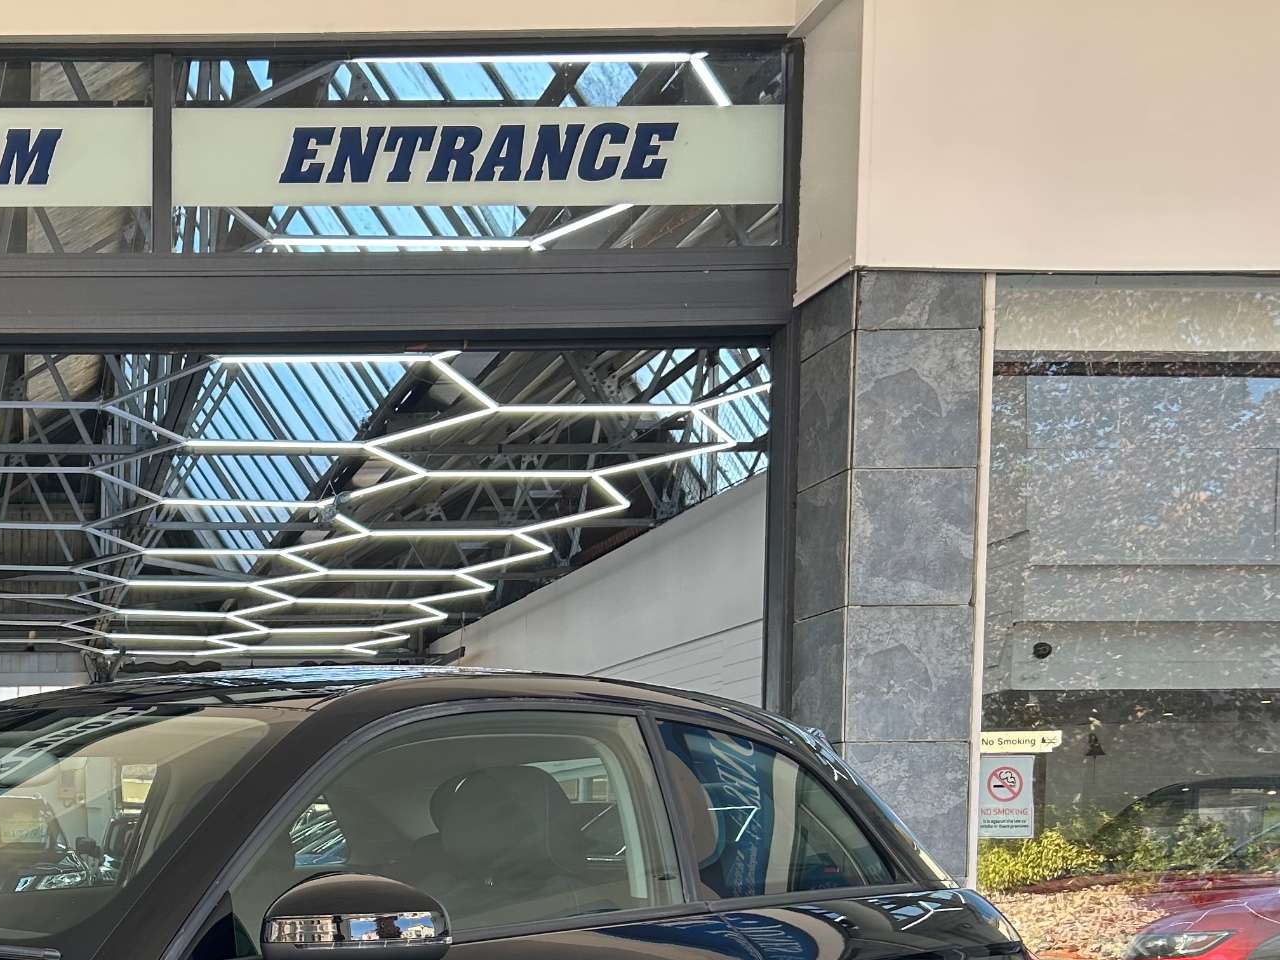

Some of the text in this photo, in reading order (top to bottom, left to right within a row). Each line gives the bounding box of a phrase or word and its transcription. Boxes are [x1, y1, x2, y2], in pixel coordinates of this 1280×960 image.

[278, 122, 679, 184] ENTRANCE
[981, 738, 1036, 746] No Smoking
[981, 808, 1029, 816] NO SMOKING
